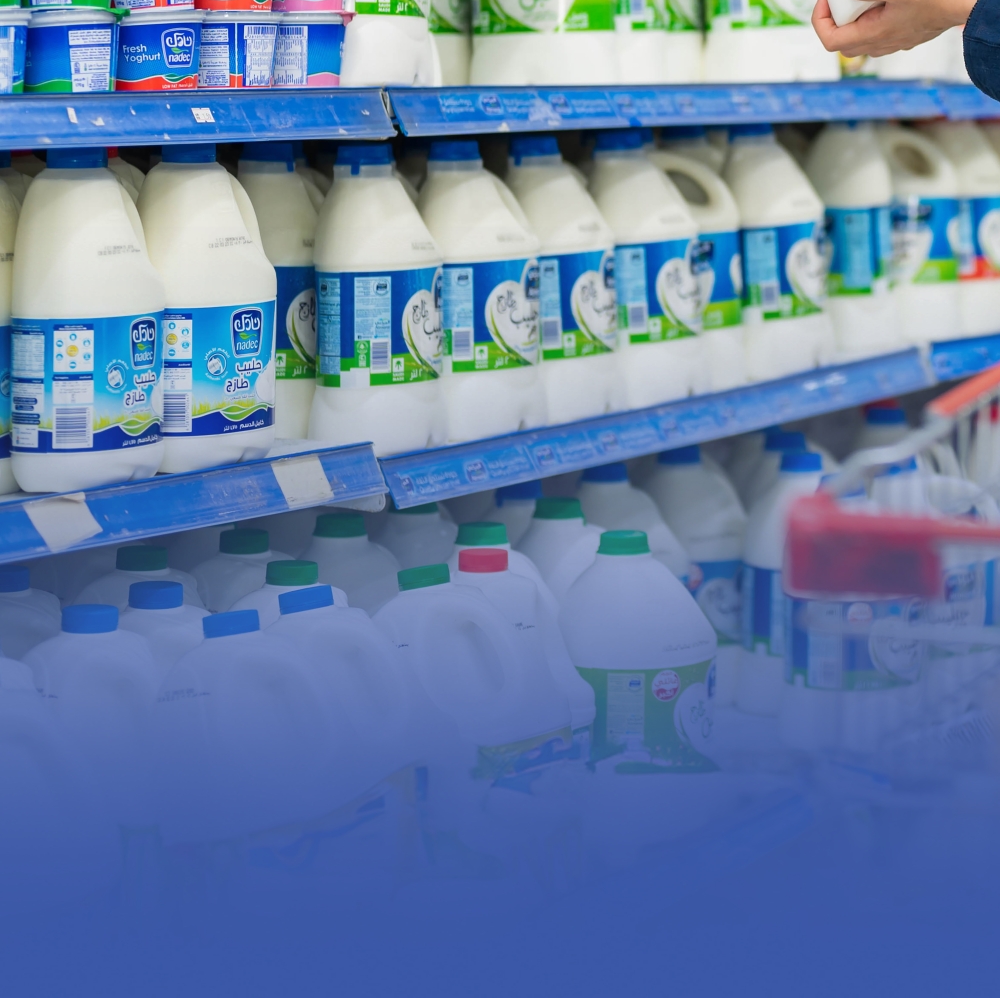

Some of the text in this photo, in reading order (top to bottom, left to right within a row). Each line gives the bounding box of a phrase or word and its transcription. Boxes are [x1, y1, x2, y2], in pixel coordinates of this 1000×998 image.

[166, 32, 192, 48] نادك
[123, 44, 147, 54] Fresh
[124, 52, 161, 64] Yoghurt
[168, 53, 190, 63] nadec
[234, 313, 260, 332] نادك
[132, 324, 154, 342] نادك
[236, 339, 258, 351] nadec
[134, 352, 153, 362] nadec
[236, 360, 262, 374] حليب
[134, 372, 156, 388] حليب
[226, 378, 248, 393] طازج
[125, 391, 145, 406] طازج
